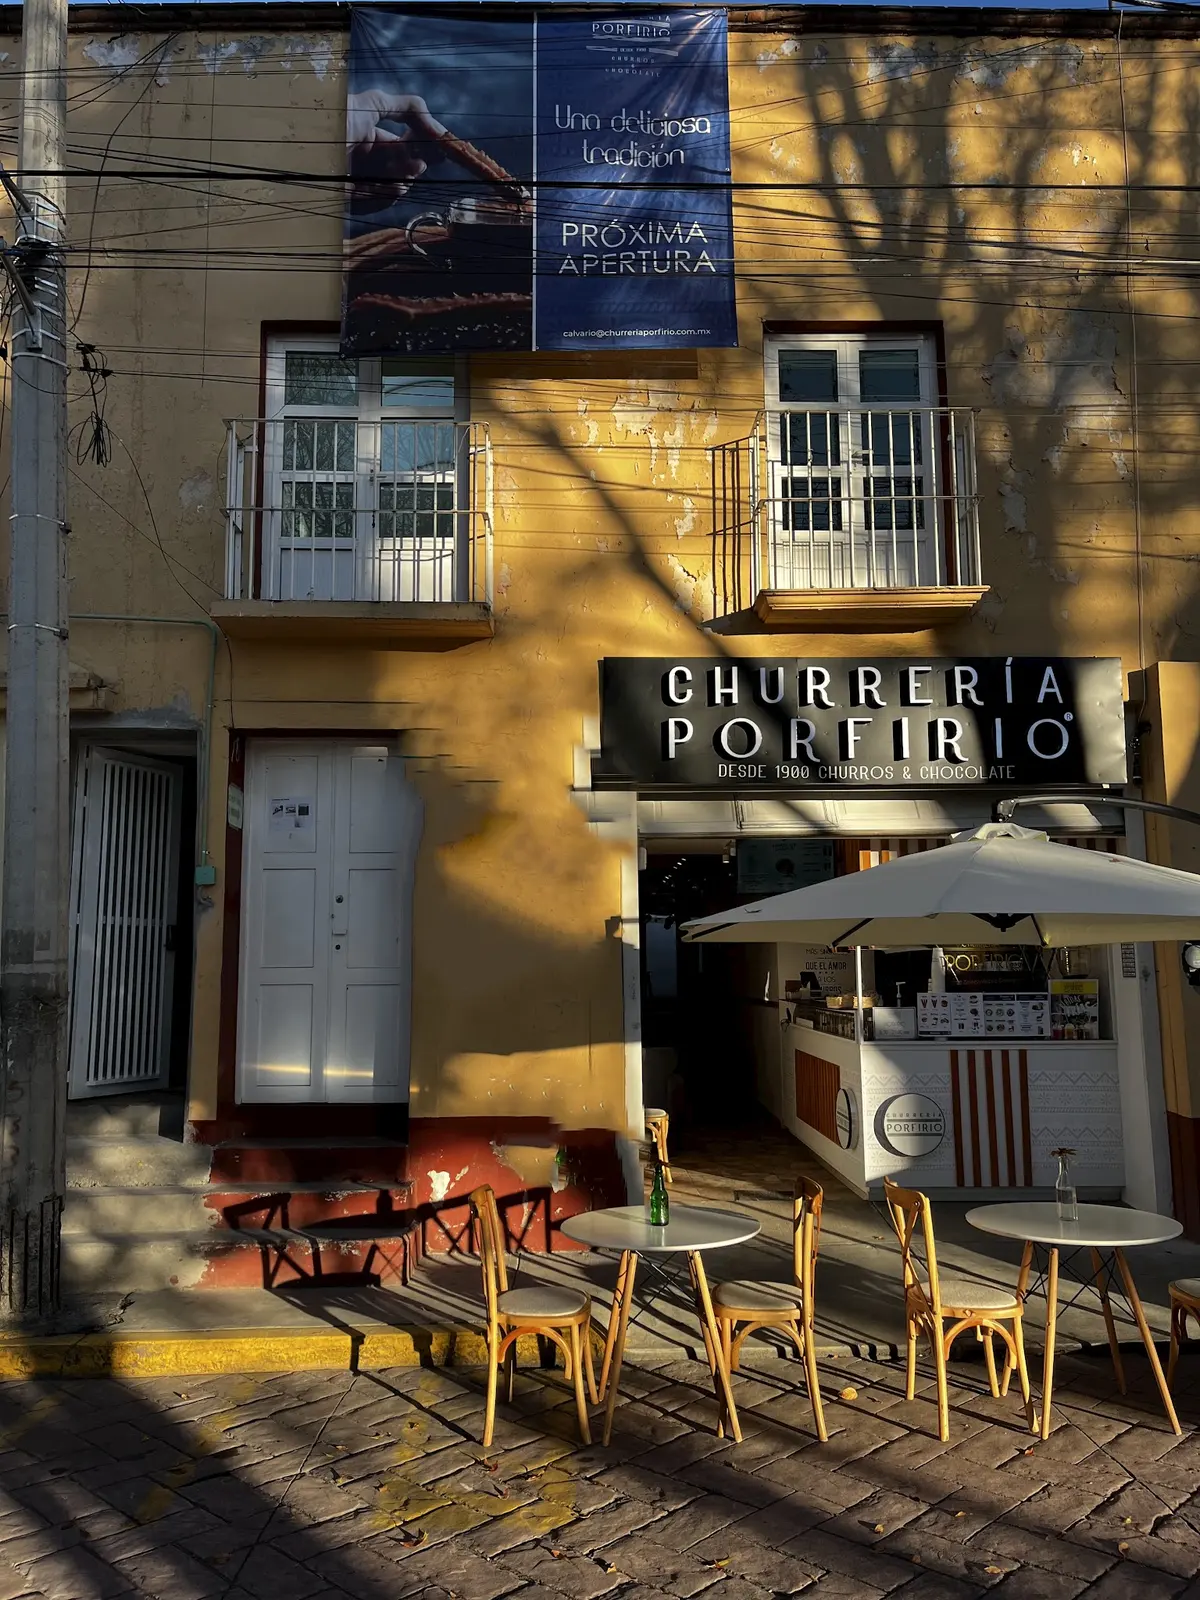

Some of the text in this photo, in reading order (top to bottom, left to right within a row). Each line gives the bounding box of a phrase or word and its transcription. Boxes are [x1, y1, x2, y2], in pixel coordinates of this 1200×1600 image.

[592, 23, 672, 38] PORFIRIO
[555, 104, 711, 137] Una deliciosa
[582, 138, 685, 169] tradición
[562, 218, 708, 248] PRÓXIMA
[558, 250, 716, 275] APERTURA
[668, 657, 1064, 706] CHURRERÍA
[718, 764, 1016, 781] DESDE 1900 CHURROS & CHOCOLATE
[805, 961, 847, 970] QUE EL AMOR
[886, 1123, 943, 1133] PORFIRIO
